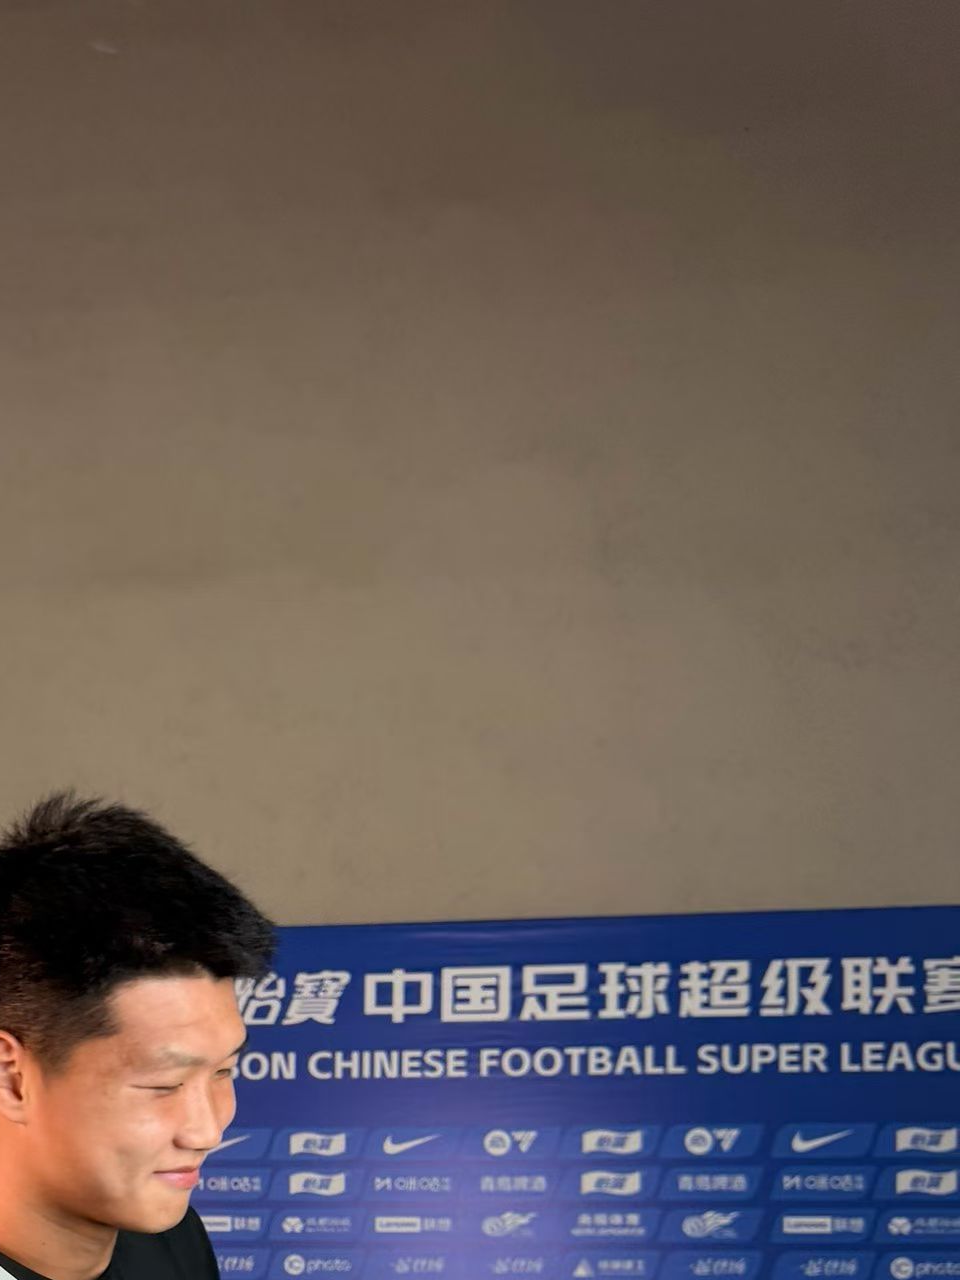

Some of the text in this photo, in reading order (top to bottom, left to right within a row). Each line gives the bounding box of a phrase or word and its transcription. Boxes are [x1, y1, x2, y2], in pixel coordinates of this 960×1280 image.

[307, 1049, 468, 1080] CHINESE
[479, 1045, 687, 1078] FOOTBALL
[697, 1042, 829, 1075] SUPER
